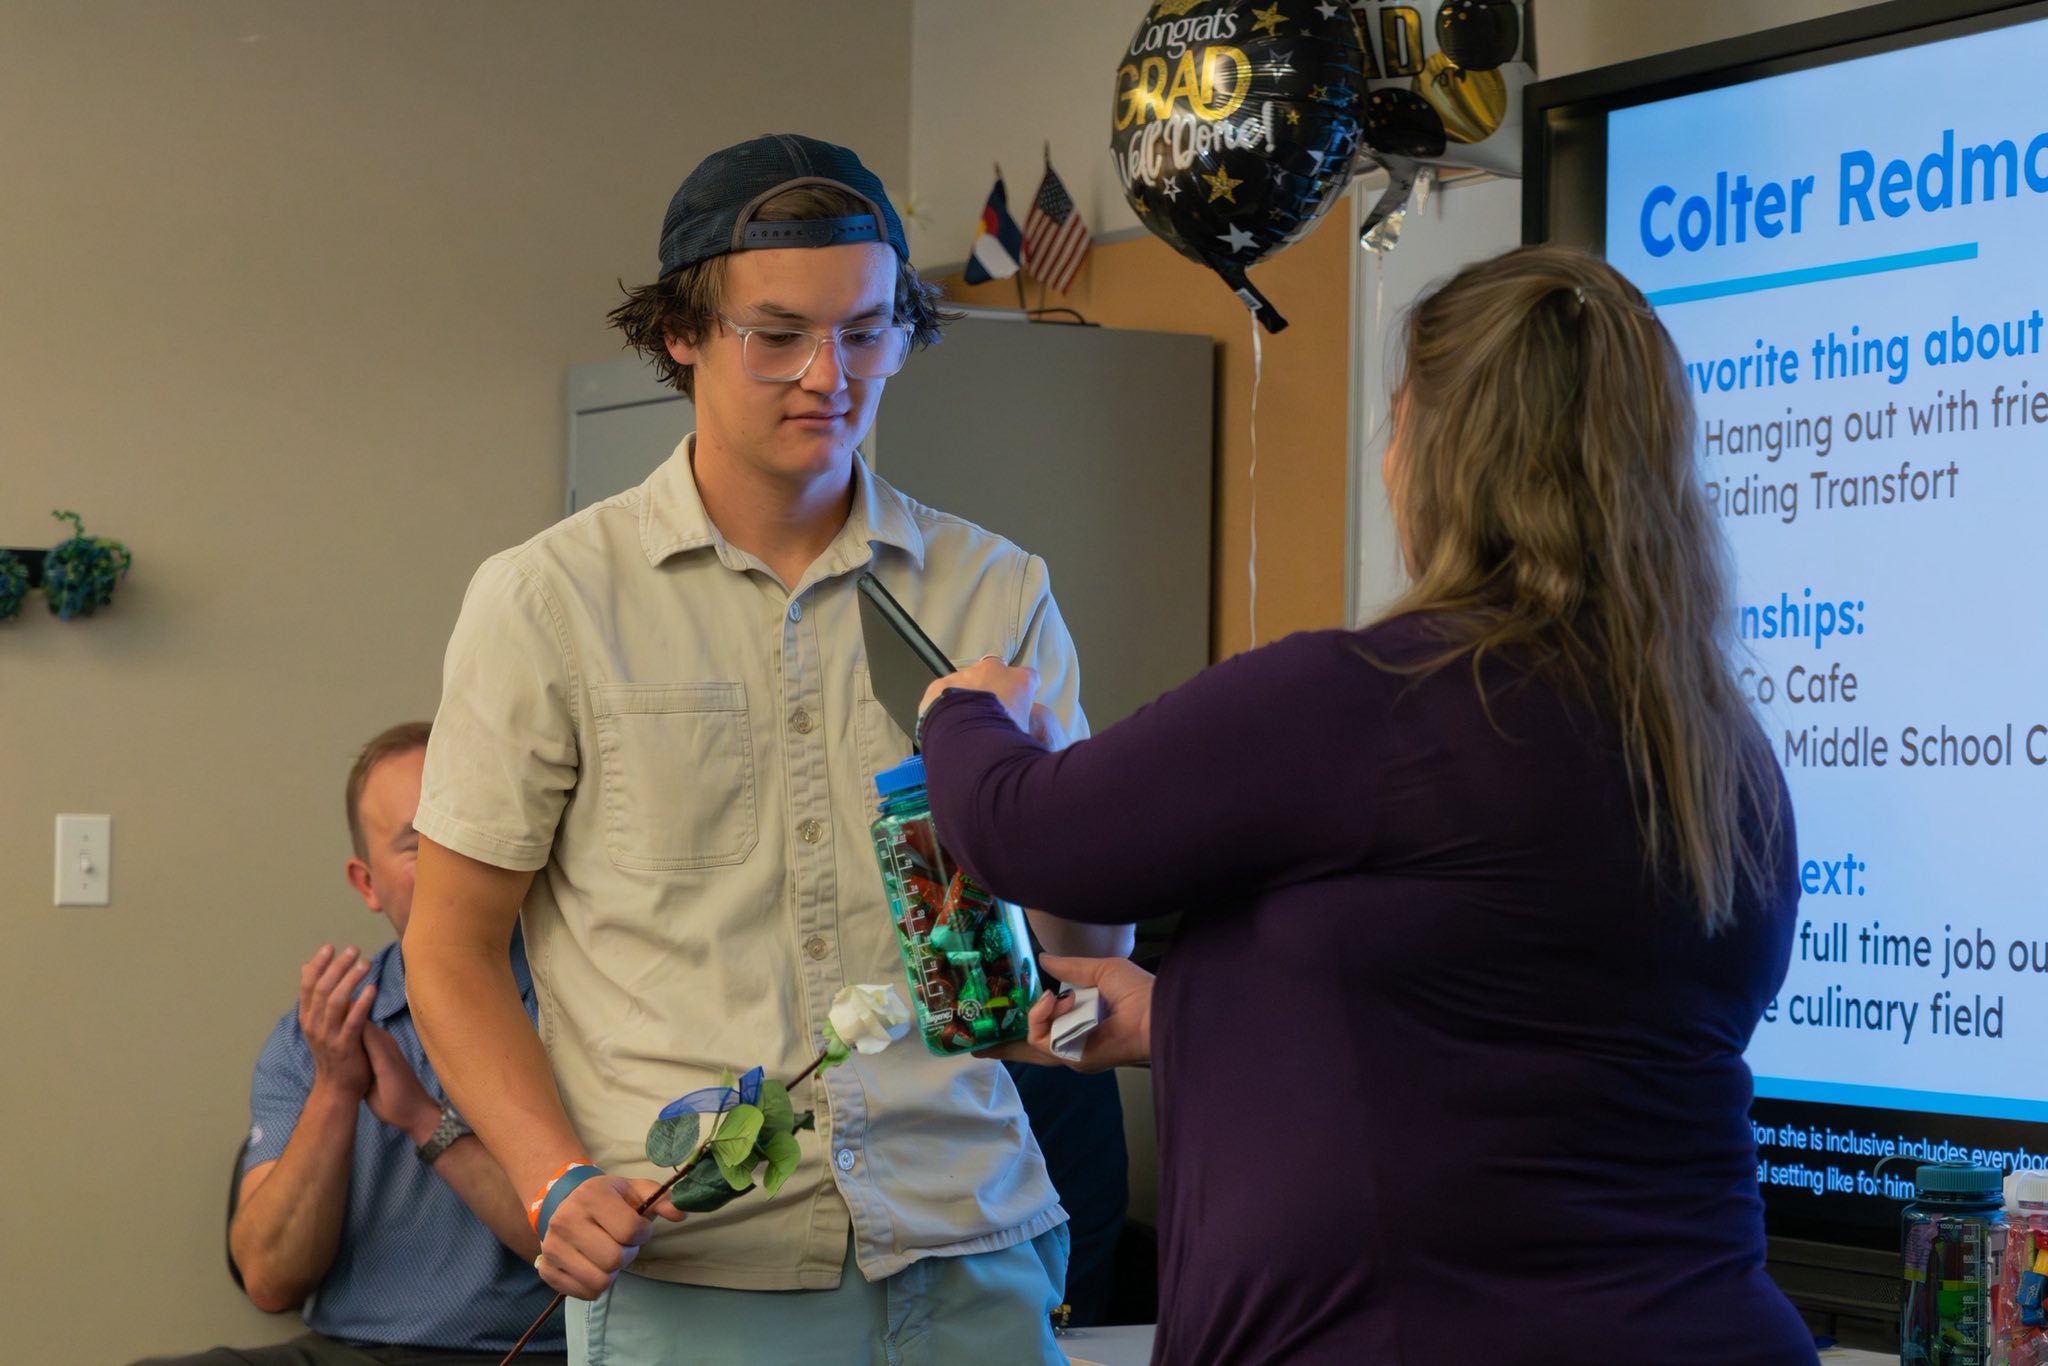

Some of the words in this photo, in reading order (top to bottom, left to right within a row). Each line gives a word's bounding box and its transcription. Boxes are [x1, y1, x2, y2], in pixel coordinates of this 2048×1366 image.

[1130, 7, 1239, 59] Congrats
[1114, 45, 1252, 131] GRAD
[1163, 100, 1275, 170] Done!
[1640, 170, 1814, 258] Colter
[1838, 128, 2048, 226] Redmo
[1686, 338, 1799, 395] vorite
[1811, 325, 1909, 384] thing
[1923, 309, 2045, 367] about
[1704, 407, 1833, 463] Hanging
[1843, 402, 1897, 443] out
[1908, 389, 1978, 436] with
[1991, 379, 2048, 428] frie
[1703, 473, 1798, 524] Riding
[1810, 460, 1960, 511] Transfort
[1741, 587, 1865, 649] nships:
[1786, 663, 1859, 704] Cafe
[1784, 725, 1889, 768] Middle
[1900, 723, 2012, 767] School
[1801, 853, 1866, 896] ext:
[917, 909, 926, 917] 20
[1800, 920, 1848, 963] full
[1859, 921, 1932, 968] time
[1941, 924, 1997, 979] job
[1762, 996, 1779, 1023] e
[1789, 984, 1919, 1045] culinary
[1930, 990, 2004, 1039] field
[1752, 1120, 1776, 1145] ion
[1779, 1123, 1807, 1149] she
[1810, 1125, 1823, 1151] is
[1826, 1127, 1895, 1157] inclusive
[1898, 1135, 1969, 1162] includes
[1756, 1160, 1768, 1183] al
[1770, 1163, 1824, 1196] setting
[1827, 1166, 1854, 1193] like
[1856, 1169, 1881, 1196] for
[1884, 1172, 1915, 1198] him
